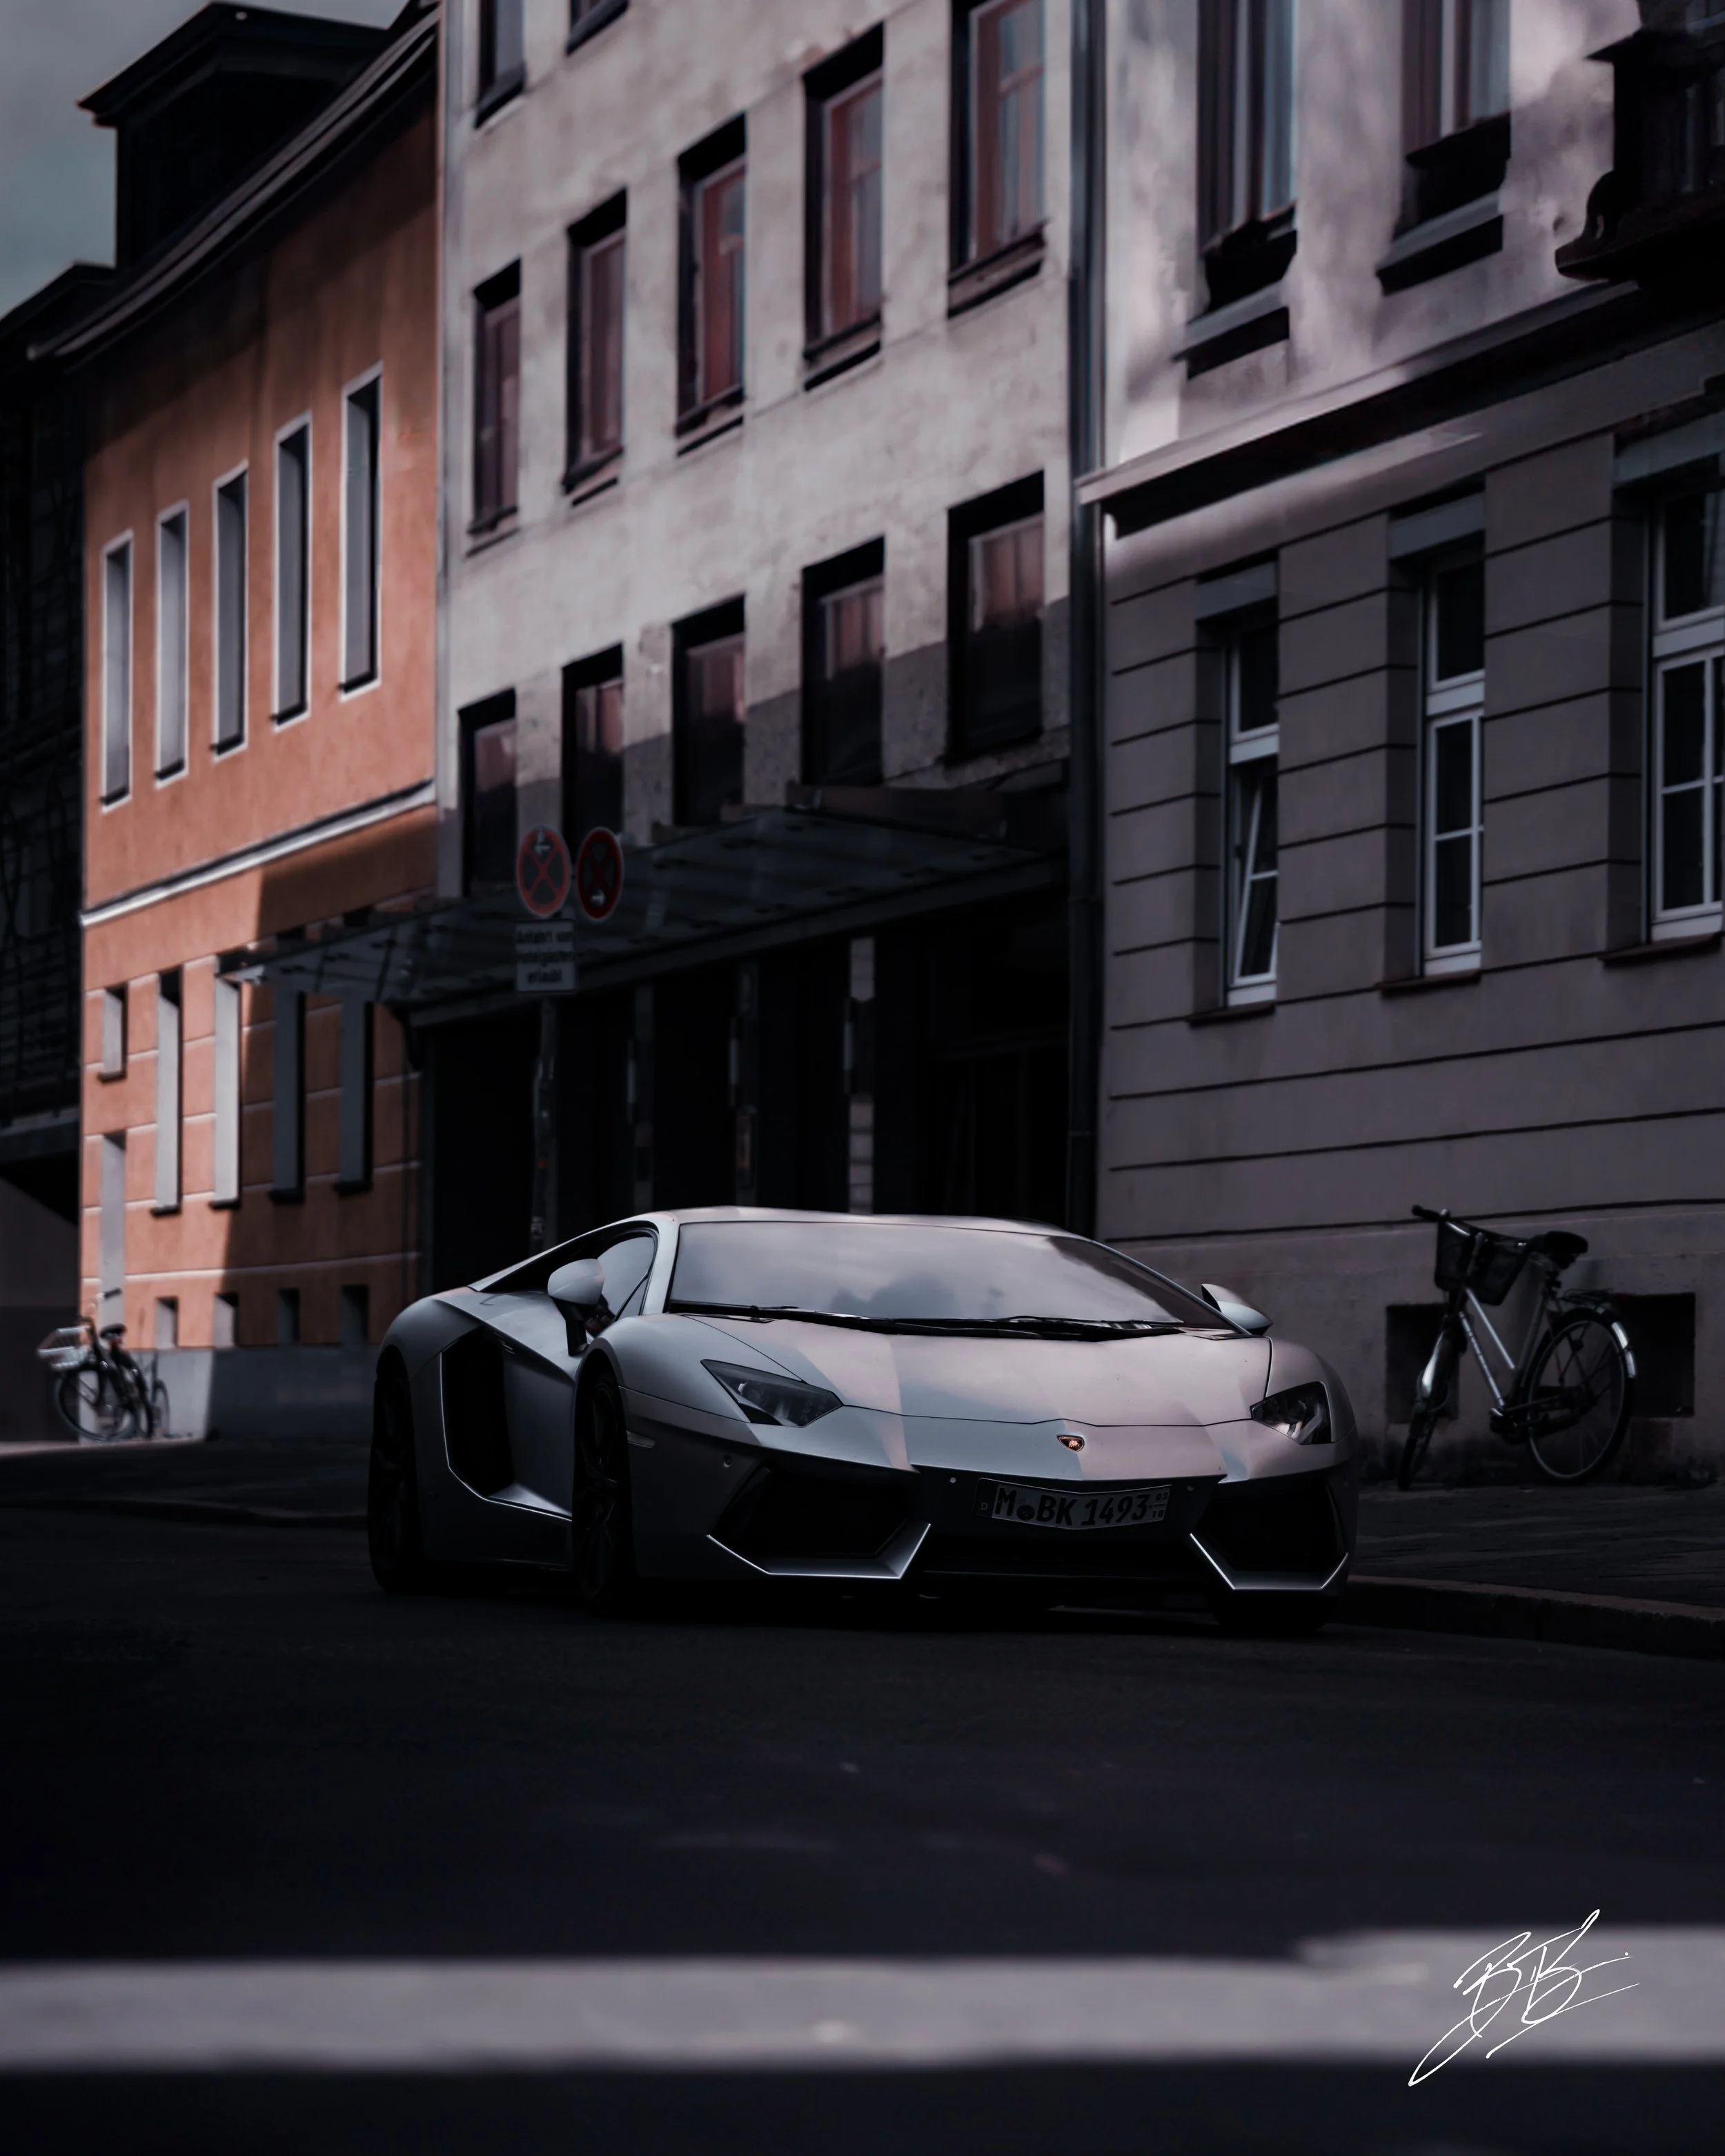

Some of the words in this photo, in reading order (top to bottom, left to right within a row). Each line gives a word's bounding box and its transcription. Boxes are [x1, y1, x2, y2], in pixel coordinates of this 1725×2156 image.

[980, 1502, 988, 1510] D
[995, 1487, 1017, 1516] M
[1036, 1494, 1077, 1525] BK
[1081, 1494, 1151, 1526] 1493
